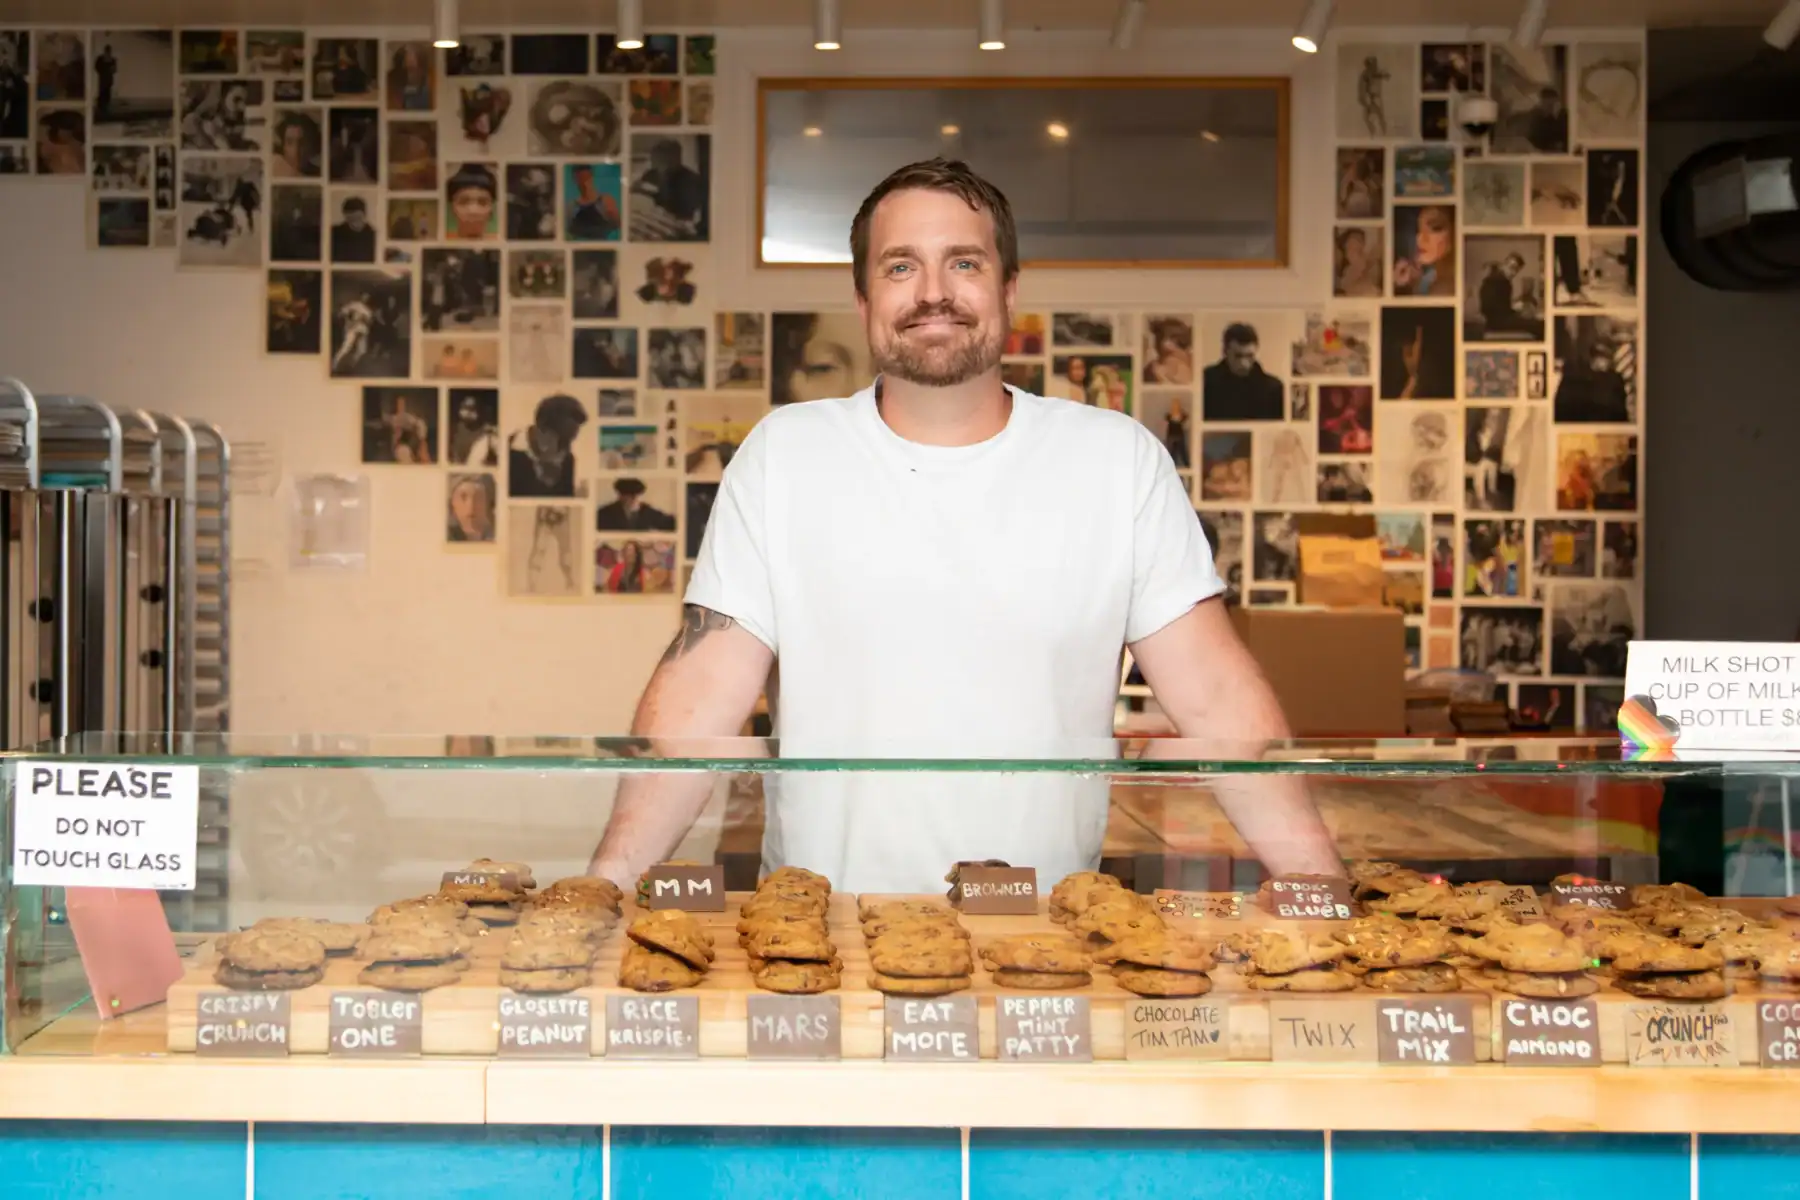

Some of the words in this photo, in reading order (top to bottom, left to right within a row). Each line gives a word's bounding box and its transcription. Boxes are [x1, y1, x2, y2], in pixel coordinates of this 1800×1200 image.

[1662, 657, 1719, 673] MILK
[1727, 656, 1796, 673] SHOT
[1649, 682, 1699, 700] CUP
[1707, 682, 1741, 700] OF
[1680, 709, 1773, 727] BOTTLE
[32, 767, 173, 799] PLEASE
[56, 818, 89, 836] DO
[96, 819, 146, 837] NOT
[19, 849, 100, 869] TOUCH
[107, 852, 181, 872] GLASS
[200, 993, 281, 1014] CRISPY
[500, 998, 589, 1018] GLOSETTE
[622, 999, 681, 1022] RiCE
[904, 1002, 954, 1024] EAT
[1004, 997, 1076, 1016] PEPPER
[1134, 1005, 1221, 1025] CHOCOLATE
[1506, 1001, 1591, 1029] CHOC
[752, 1013, 830, 1042] MARS
[1018, 1016, 1069, 1034] MiNT
[1382, 1005, 1465, 1035] TRAiL
[198, 1022, 287, 1045] CRUNCH
[341, 1025, 398, 1048] ONE
[502, 1023, 587, 1046] PEANUT
[1132, 1029, 1167, 1049] TIM
[1170, 1026, 1210, 1047] TAM
[1279, 1017, 1356, 1049] TWIX
[1005, 1034, 1080, 1056] PATTY
[1397, 1036, 1451, 1062] MiX
